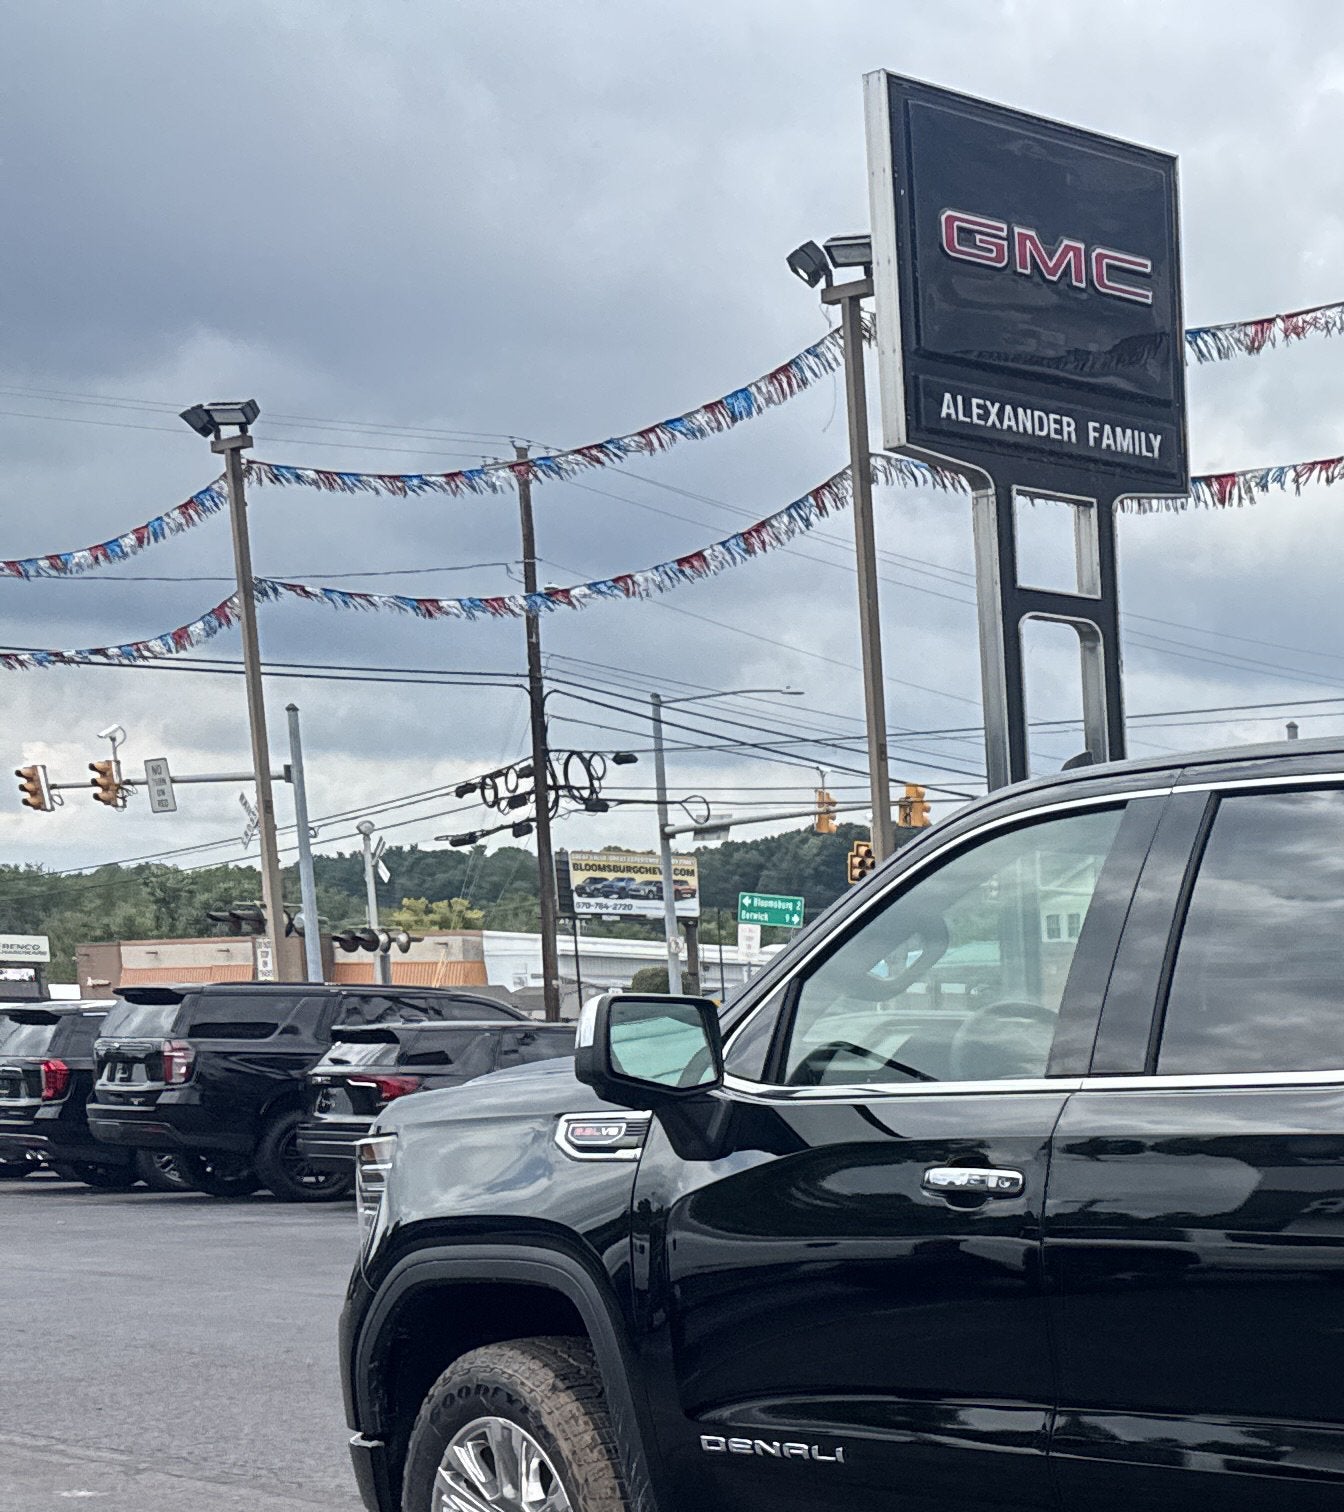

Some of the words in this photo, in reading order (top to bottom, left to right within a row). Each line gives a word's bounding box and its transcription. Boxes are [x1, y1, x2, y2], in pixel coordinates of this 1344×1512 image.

[941, 210, 1153, 305] GMC
[940, 392, 1077, 444] ALEXANDER
[1087, 421, 1163, 460] FAMILY
[572, 862, 696, 878] BLOOMSBURGCHEVCOM
[741, 909, 769, 922] Berwick
[753, 896, 794, 912] Bloomsburg
[699, 1434, 845, 1464] DENALI
